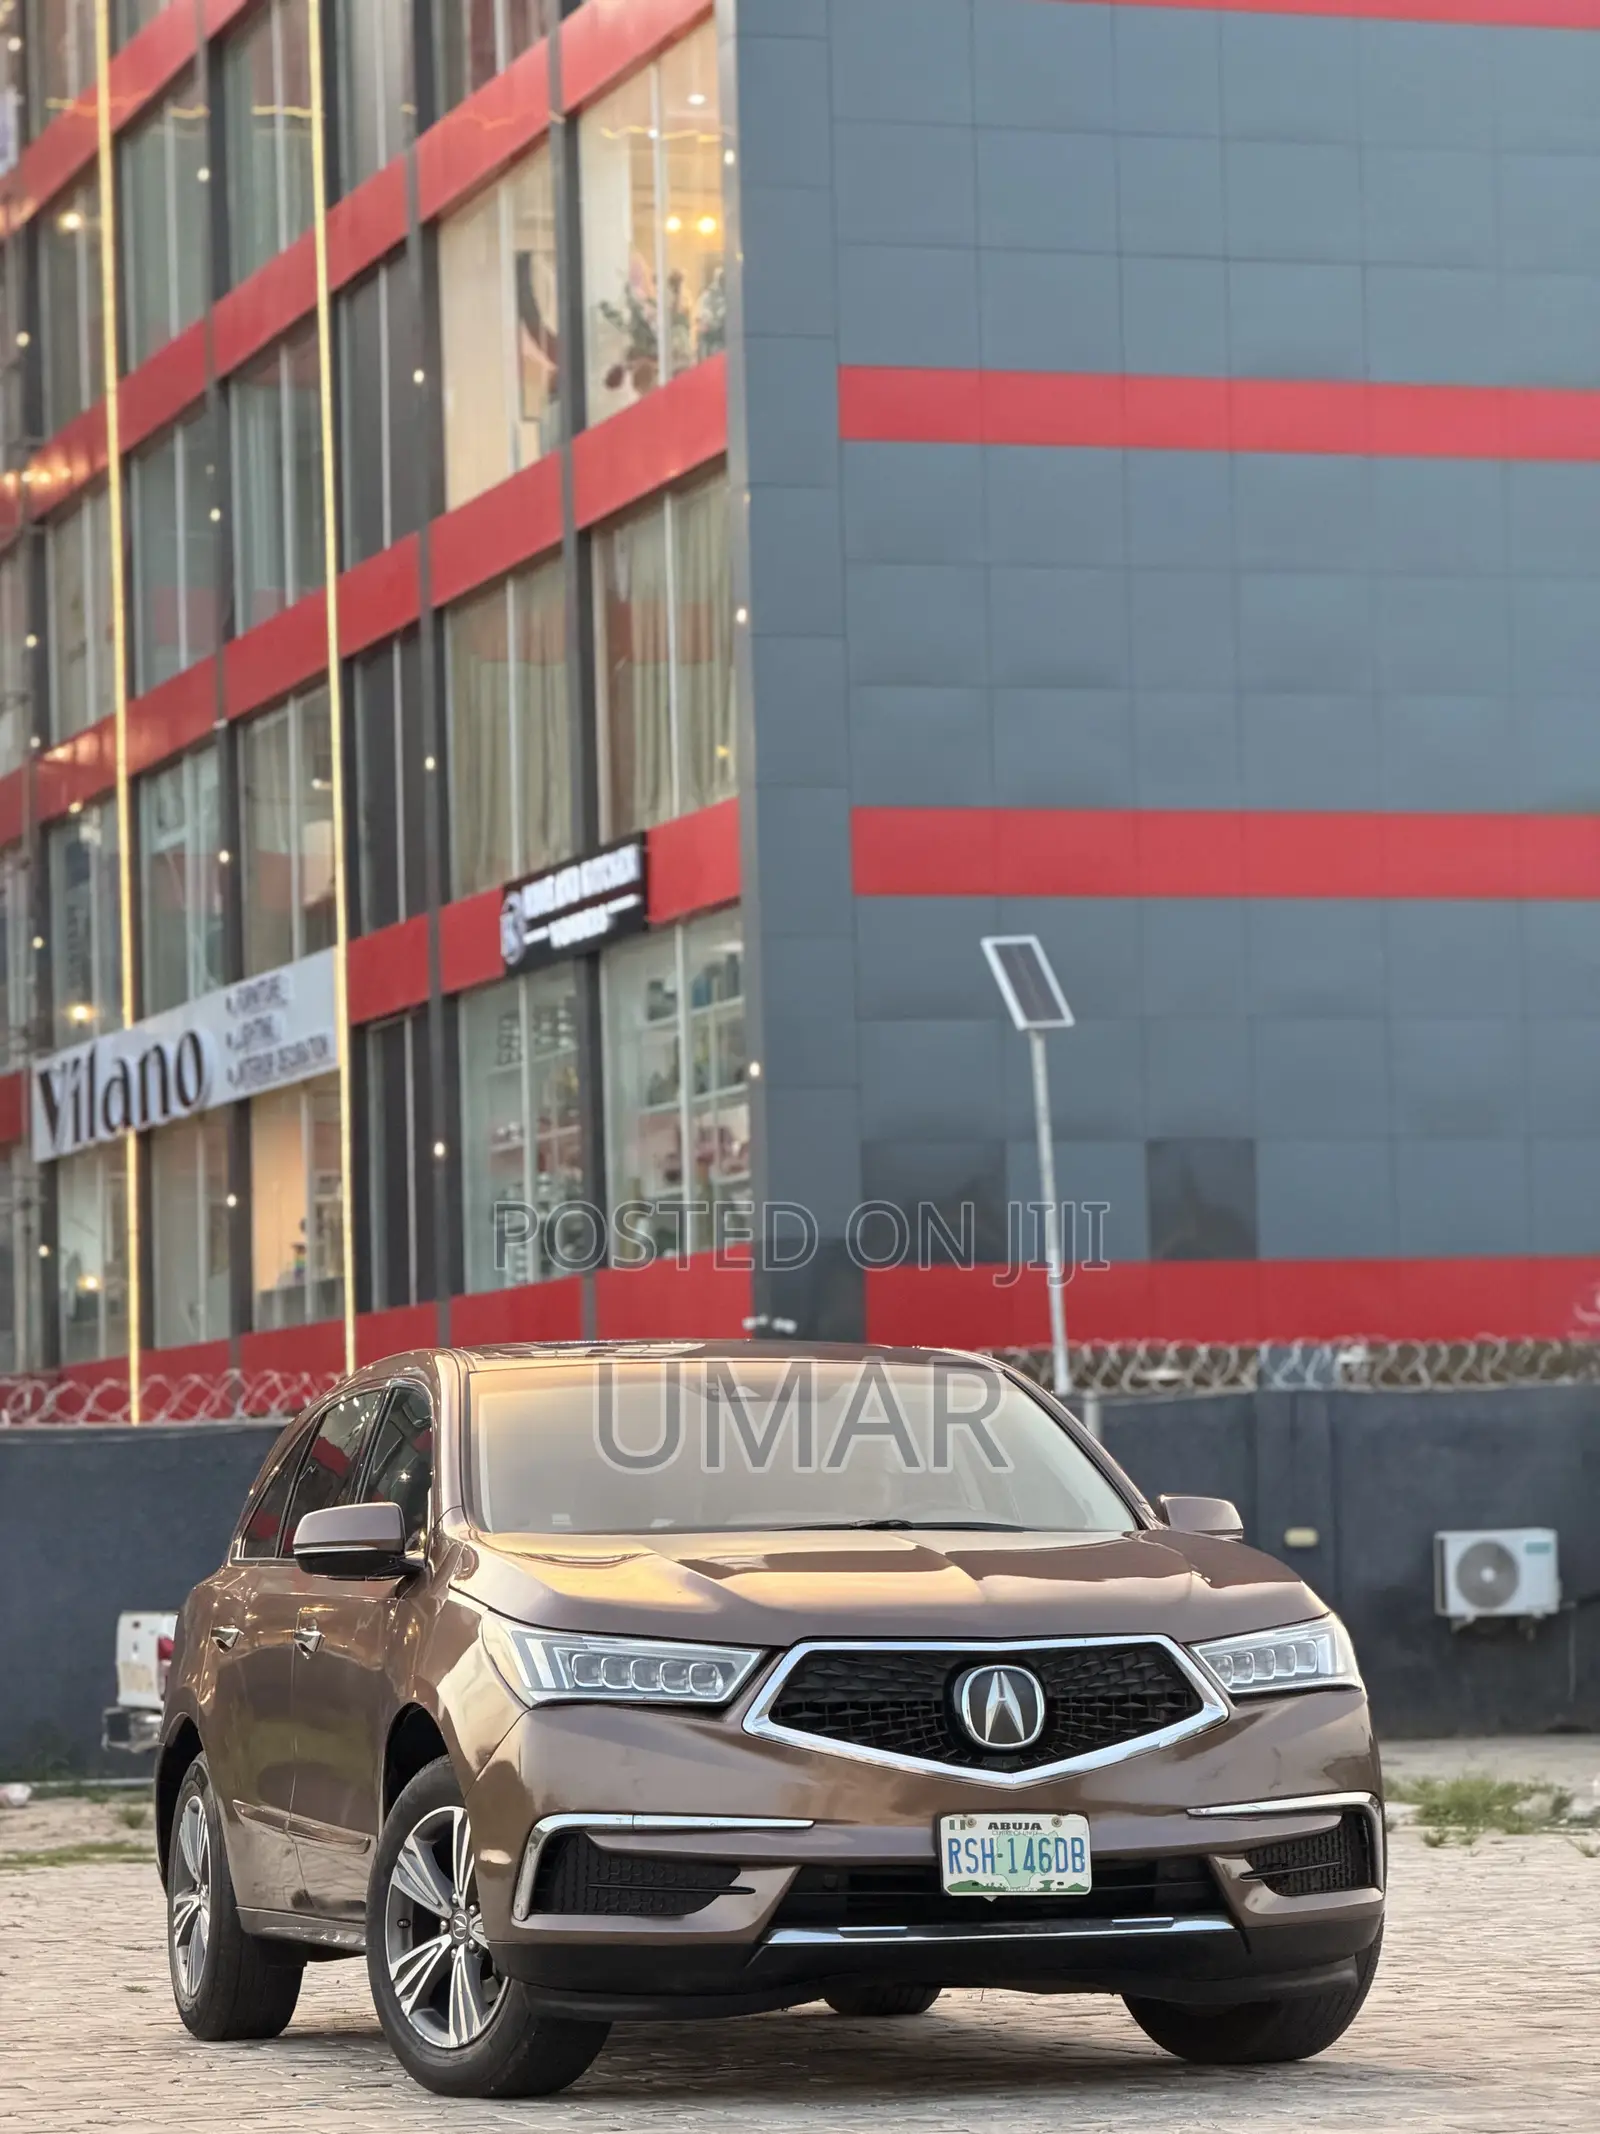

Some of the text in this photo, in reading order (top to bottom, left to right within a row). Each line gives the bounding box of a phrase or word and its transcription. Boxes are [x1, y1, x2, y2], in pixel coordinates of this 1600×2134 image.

[37, 1029, 207, 1151] Vilano
[988, 1822, 1042, 1831] ABUJA
[948, 1837, 1085, 1874] RSH-146DB
